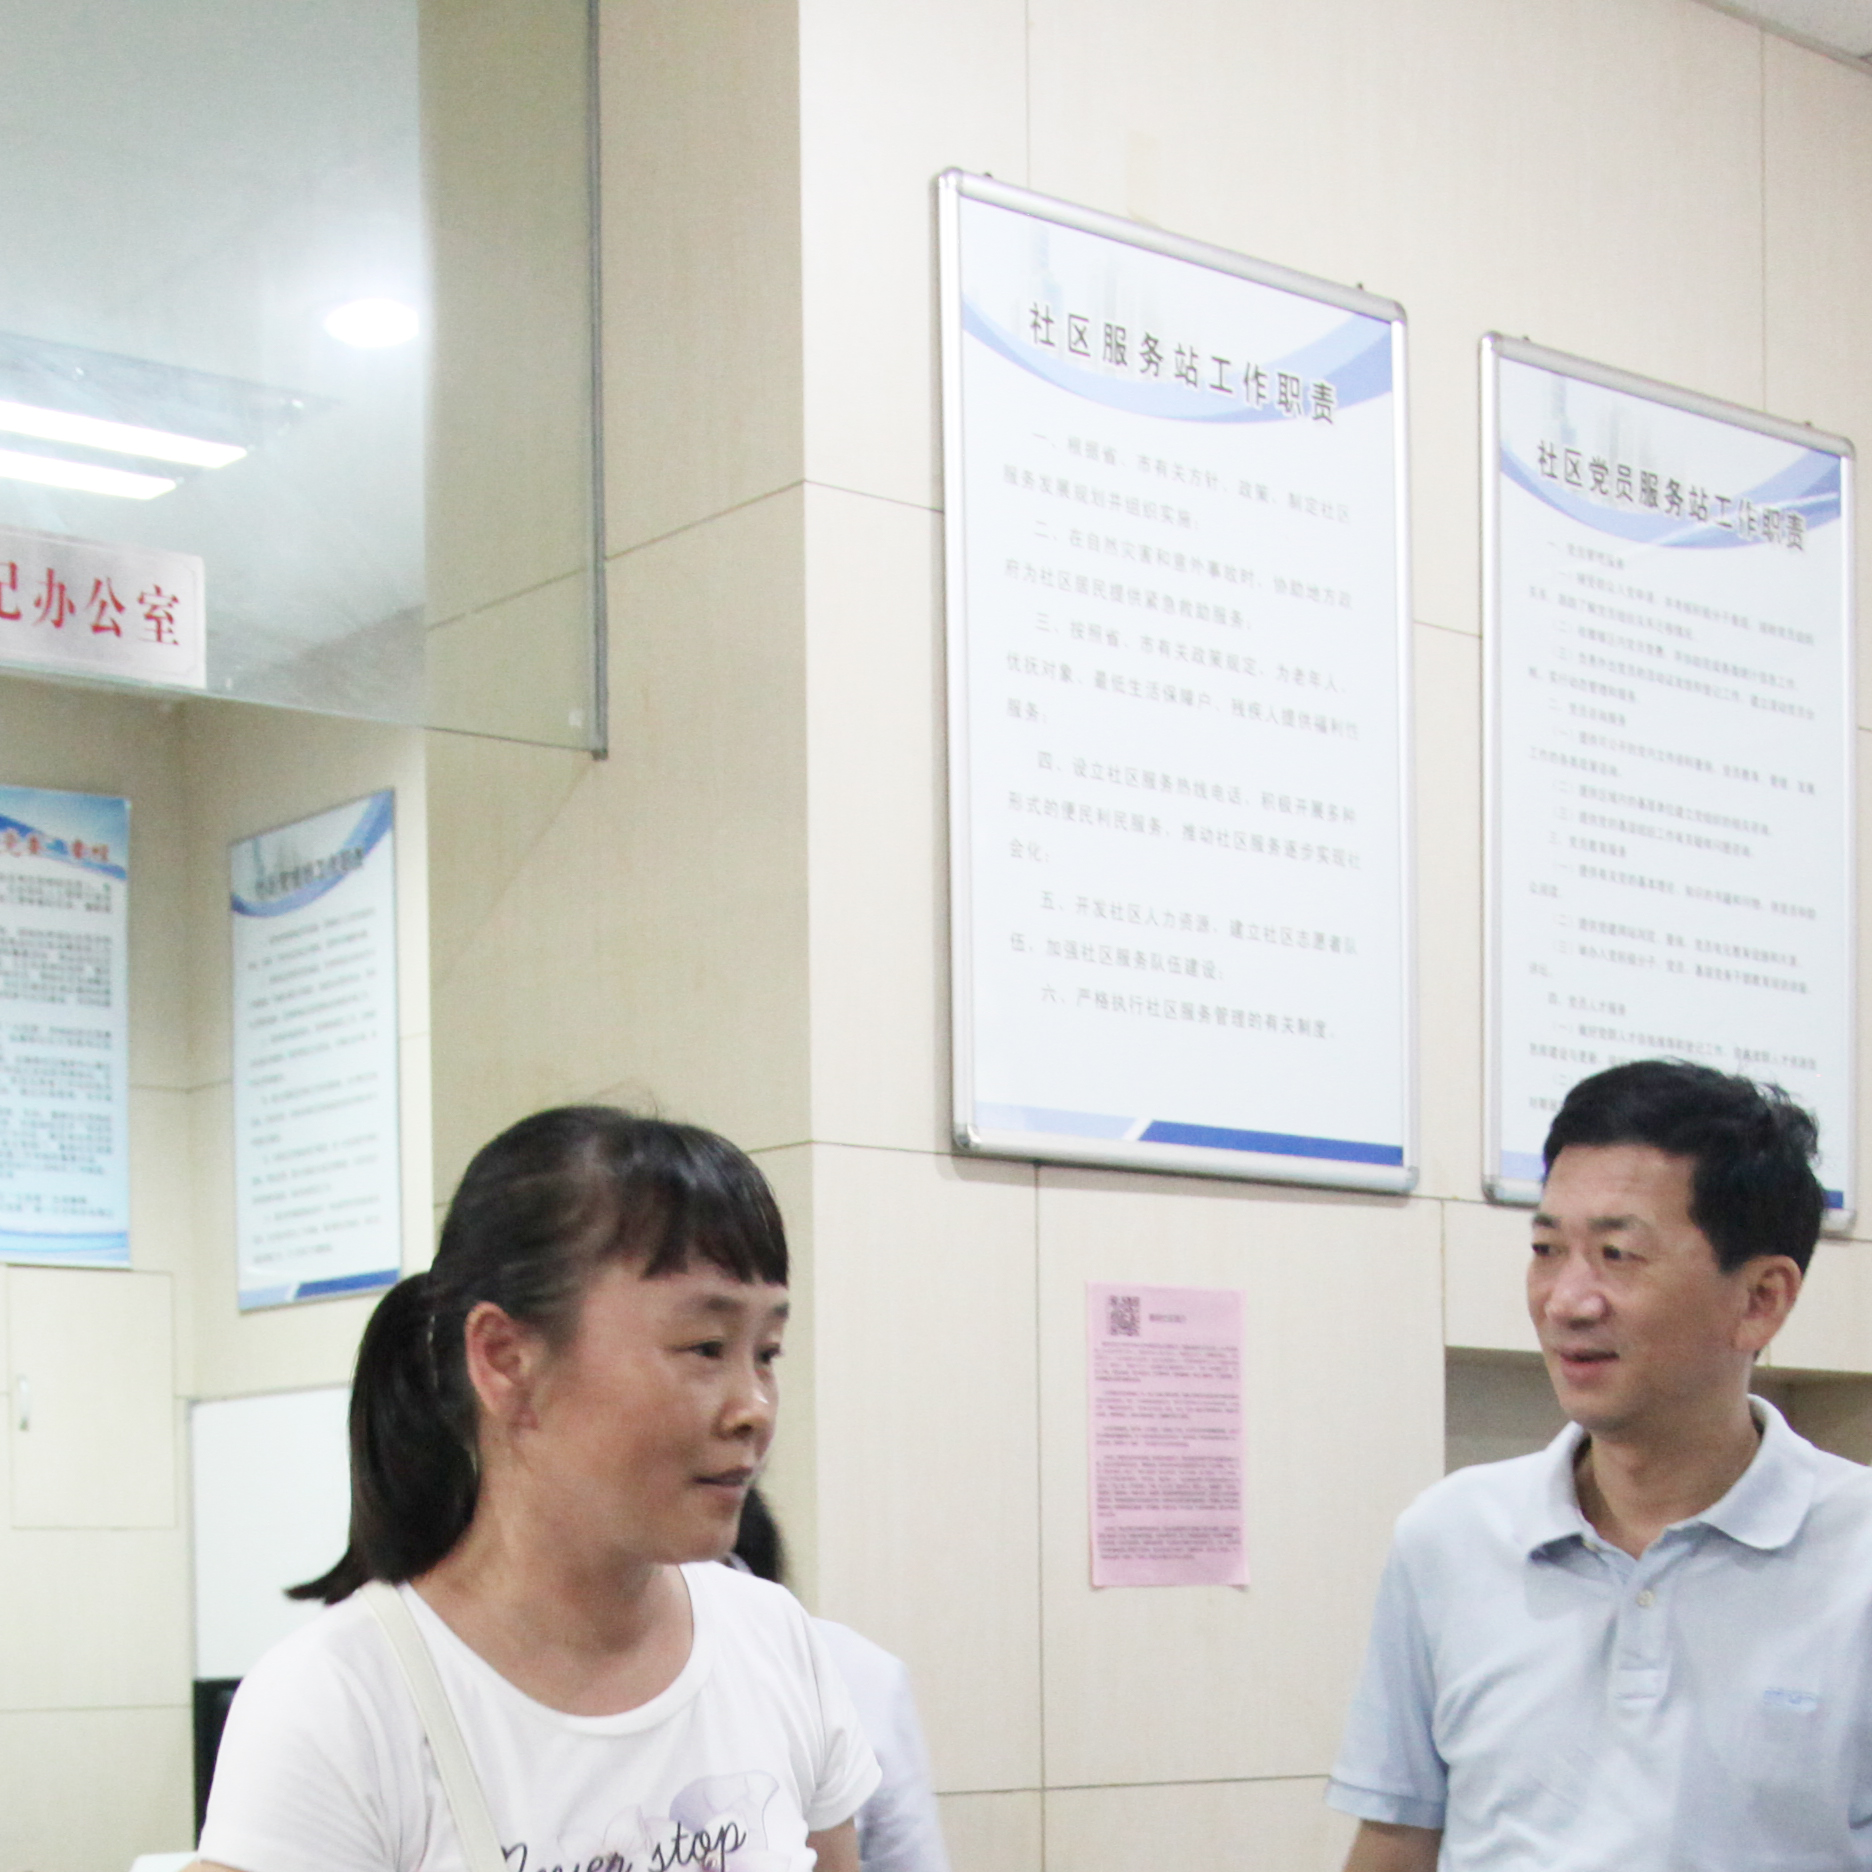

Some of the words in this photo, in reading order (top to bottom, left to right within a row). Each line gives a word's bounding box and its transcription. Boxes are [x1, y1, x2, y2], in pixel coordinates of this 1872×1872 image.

[1028, 301, 1338, 426] 社区服务站工作职责
[1536, 439, 1807, 552] 社区党员服务站工作职责
